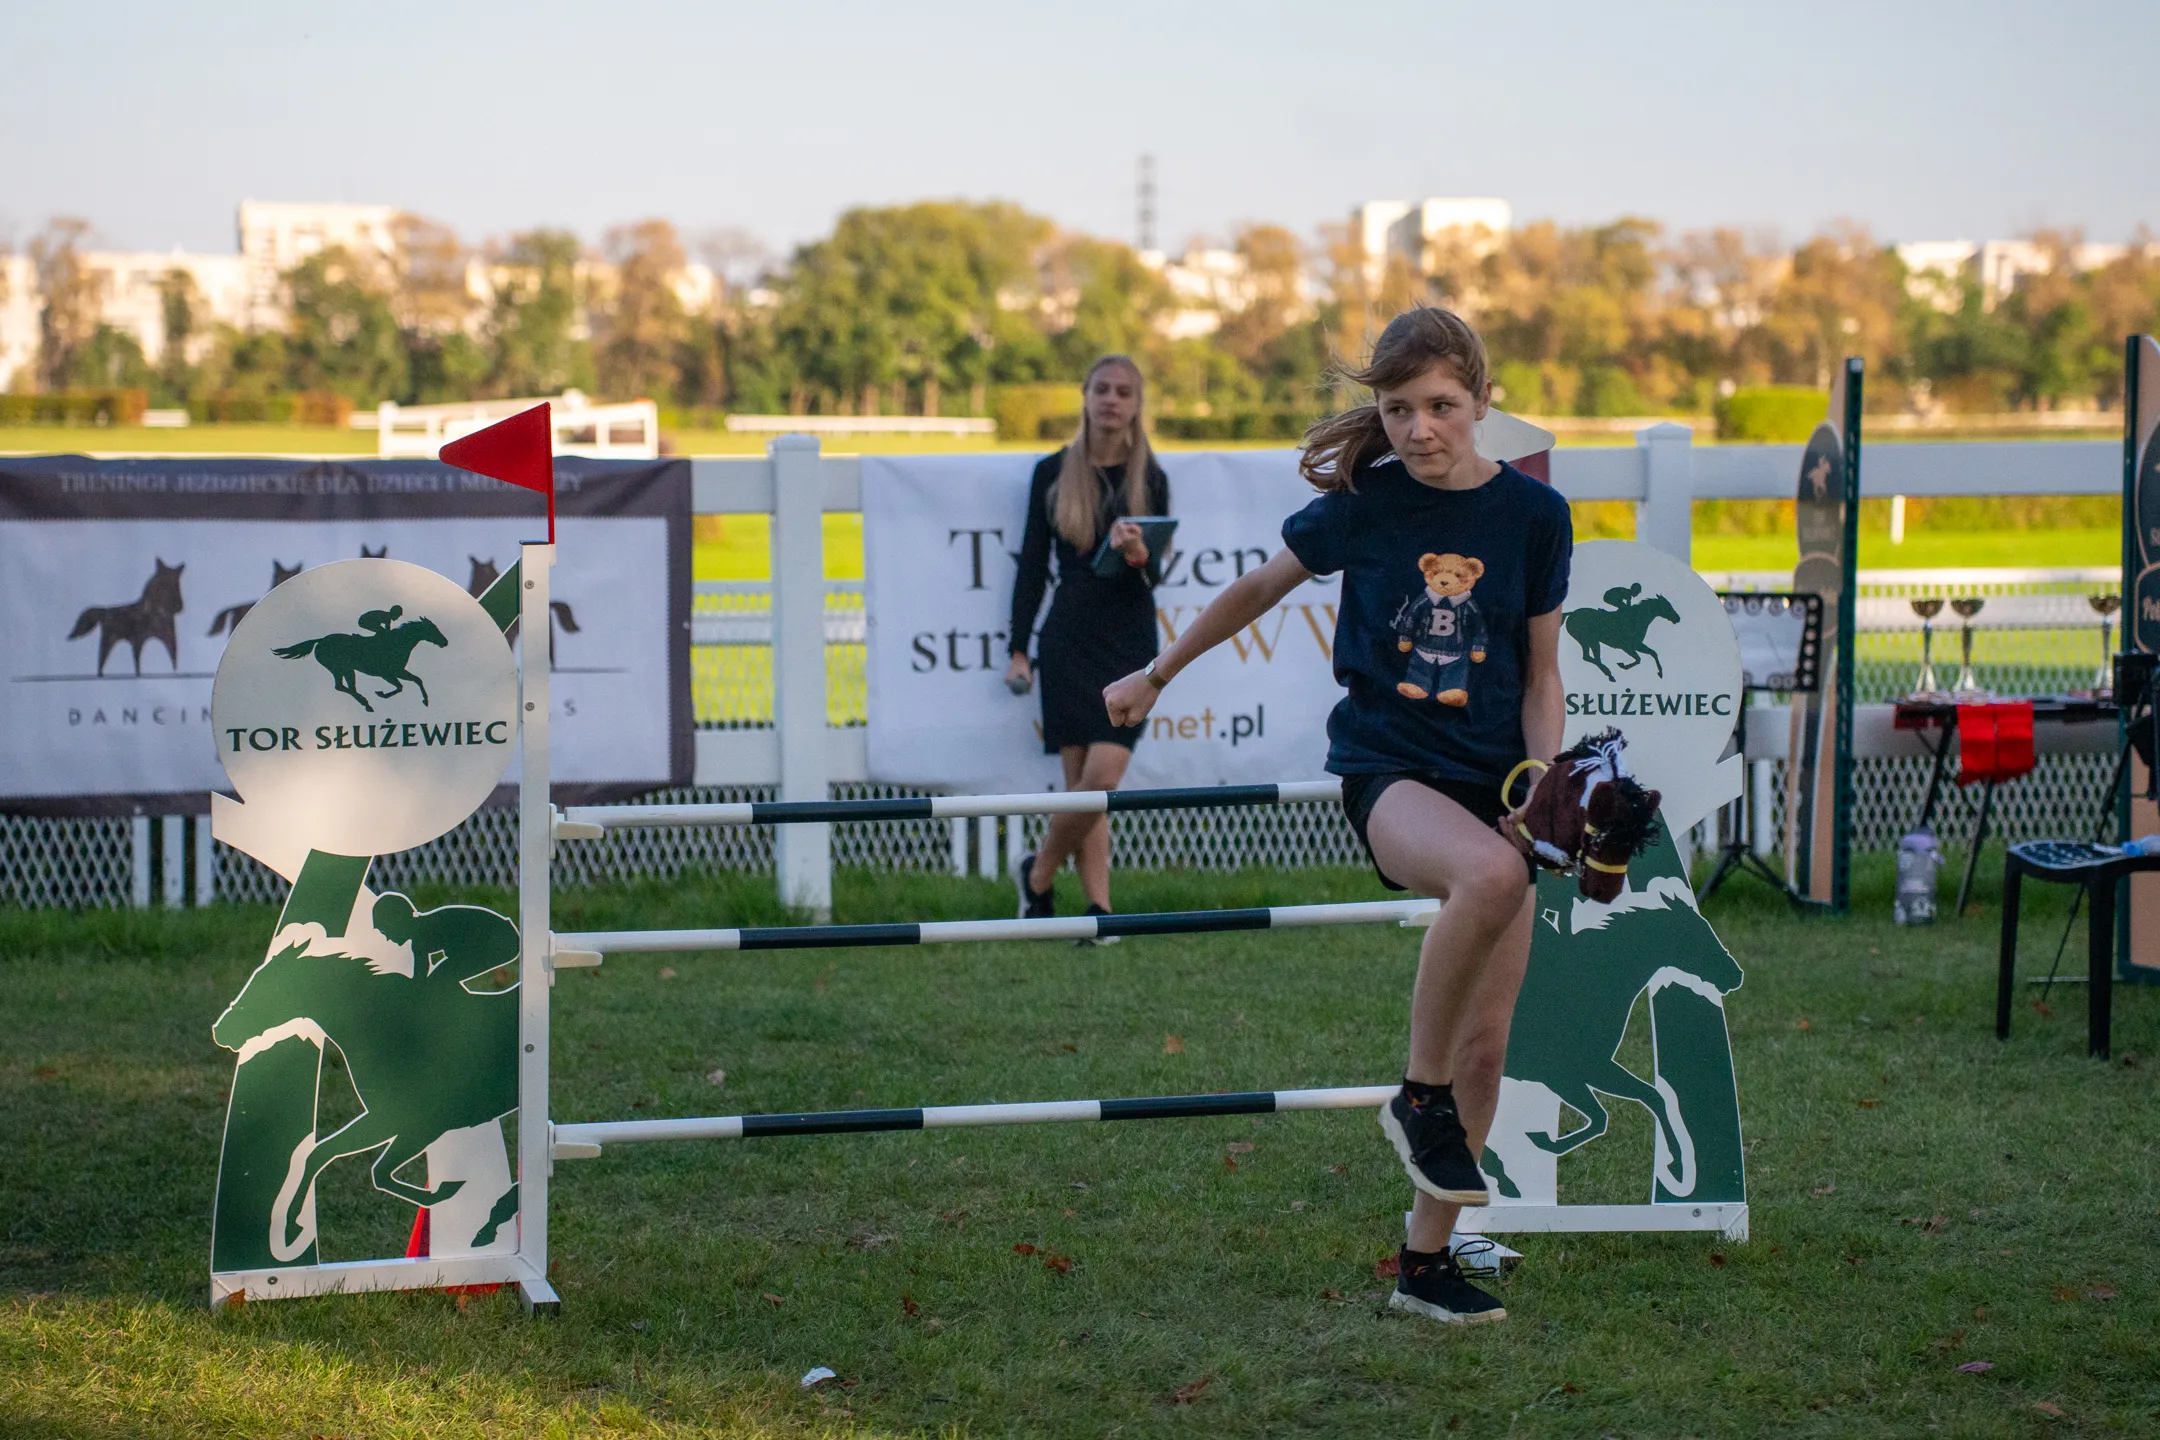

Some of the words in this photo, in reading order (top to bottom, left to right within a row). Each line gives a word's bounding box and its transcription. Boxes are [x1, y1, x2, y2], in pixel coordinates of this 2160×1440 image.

[1429, 608, 1456, 637] B
[911, 625, 1006, 673] str
[68, 706, 212, 727] DANCIN
[1565, 688, 1731, 716] SŁUŻEWIEC
[226, 727, 303, 752] TOR
[315, 718, 508, 750] SŁUŻEWIEC
